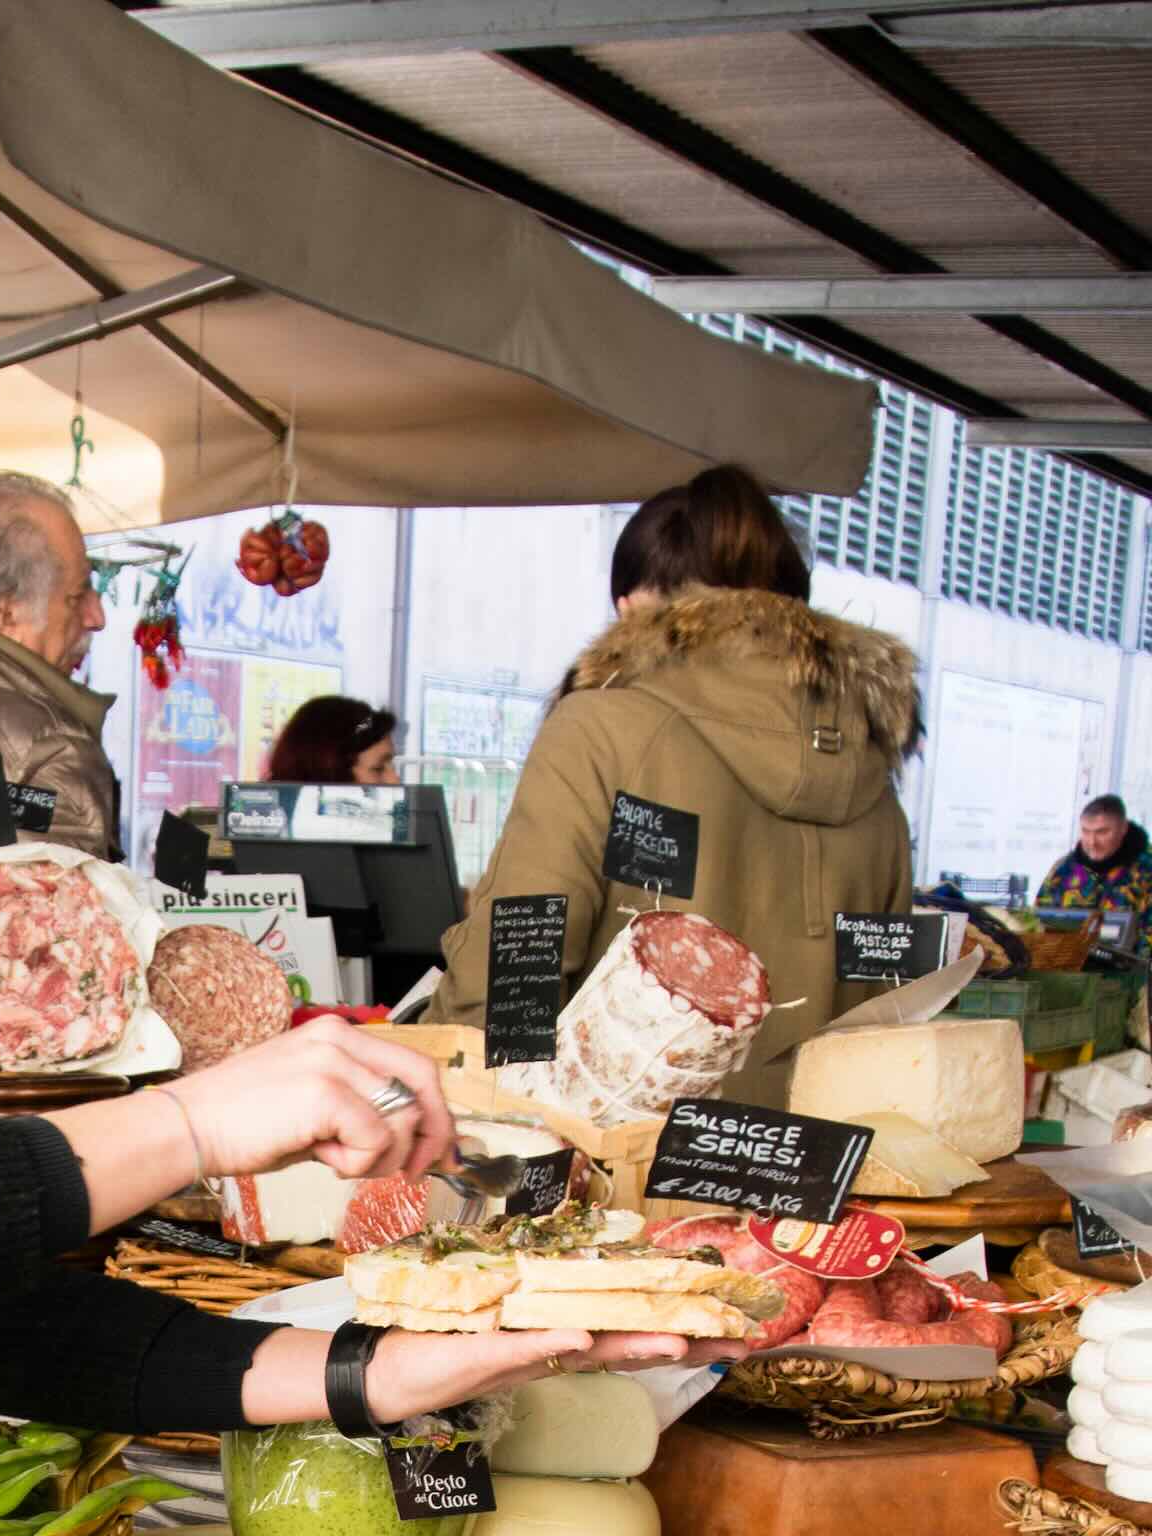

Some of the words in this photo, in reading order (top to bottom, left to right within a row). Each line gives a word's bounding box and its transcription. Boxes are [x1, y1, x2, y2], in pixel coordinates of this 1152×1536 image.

[614, 796, 664, 831] SALAME
[212, 888, 298, 908] sinceri
[888, 922, 915, 935] DEL
[852, 932, 912, 949] PASTORE
[858, 947, 903, 961] SARDO
[652, 1176, 685, 1193] €
[768, 1192, 804, 1214] KG
[423, 1473, 466, 1494] Pesto
[428, 1491, 479, 1510] Cuore
